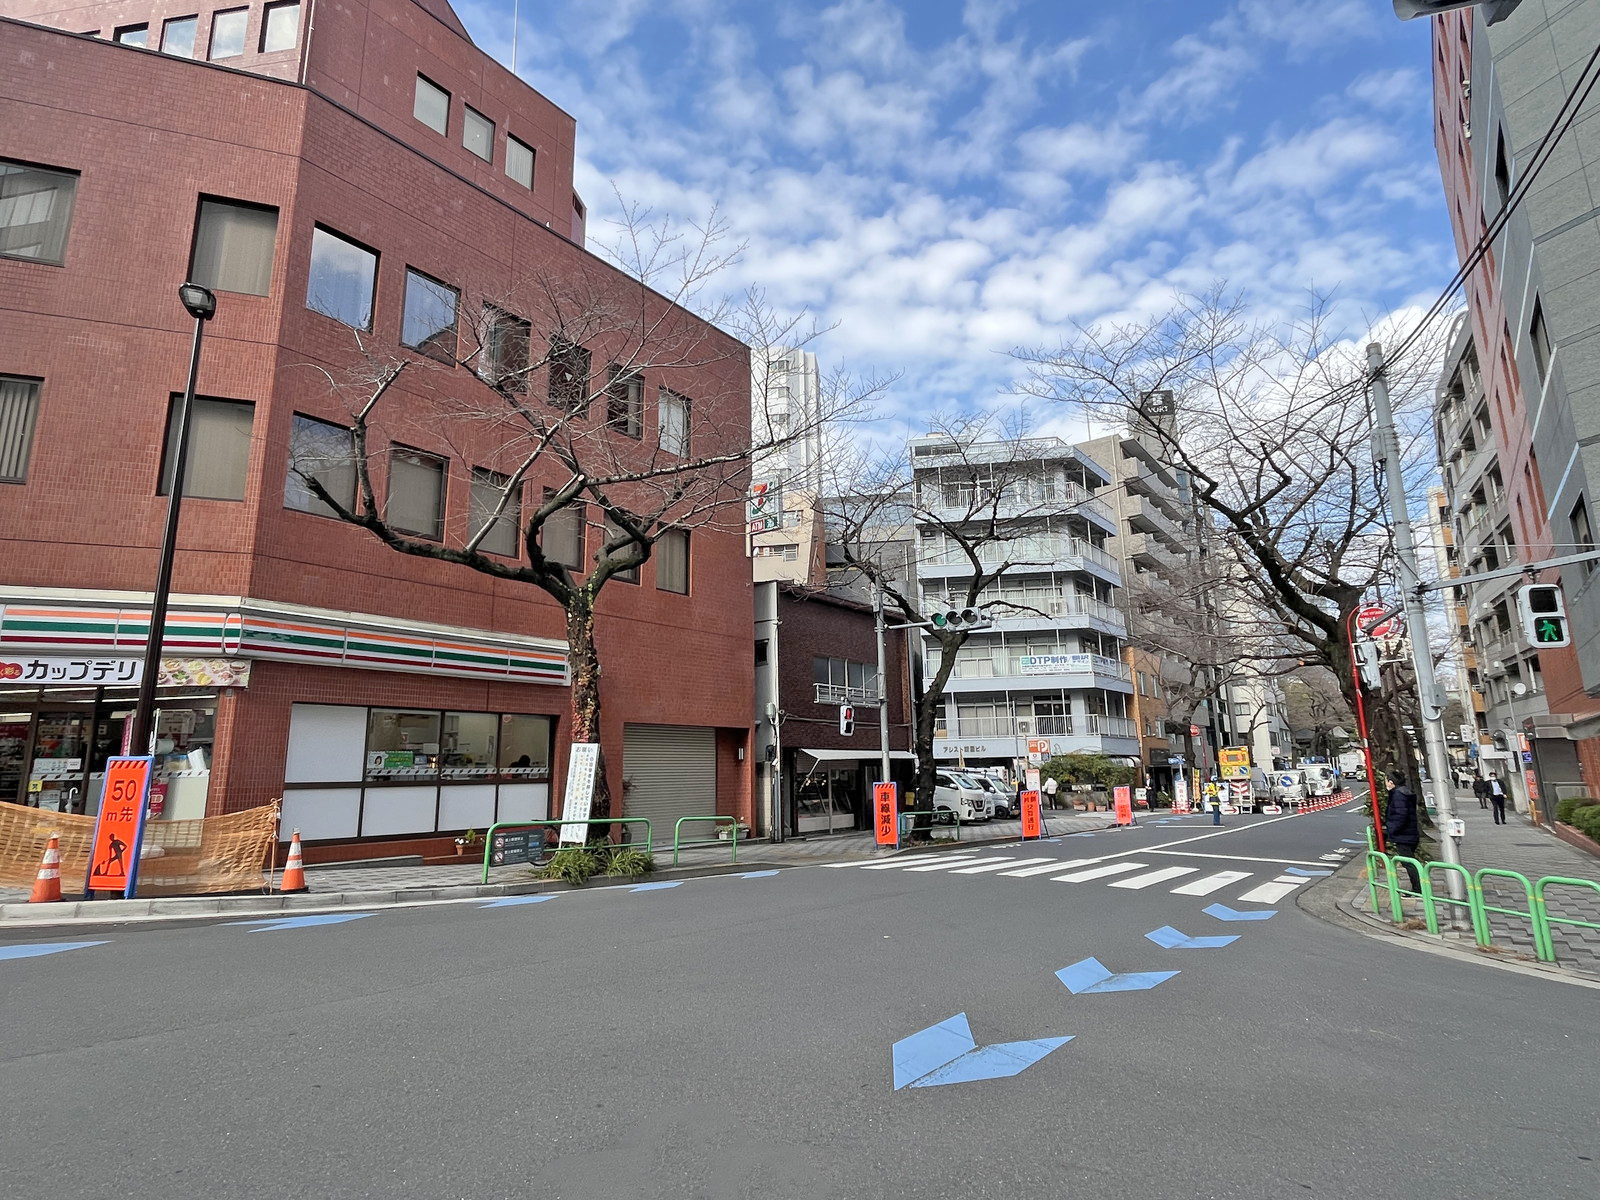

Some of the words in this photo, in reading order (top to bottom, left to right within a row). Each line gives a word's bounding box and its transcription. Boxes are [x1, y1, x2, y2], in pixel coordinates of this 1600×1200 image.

[25, 660, 137, 680] カップデリ
[111, 780, 137, 801] 50
[106, 807, 133, 822] m先
[880, 791, 892, 837] 車線減少
